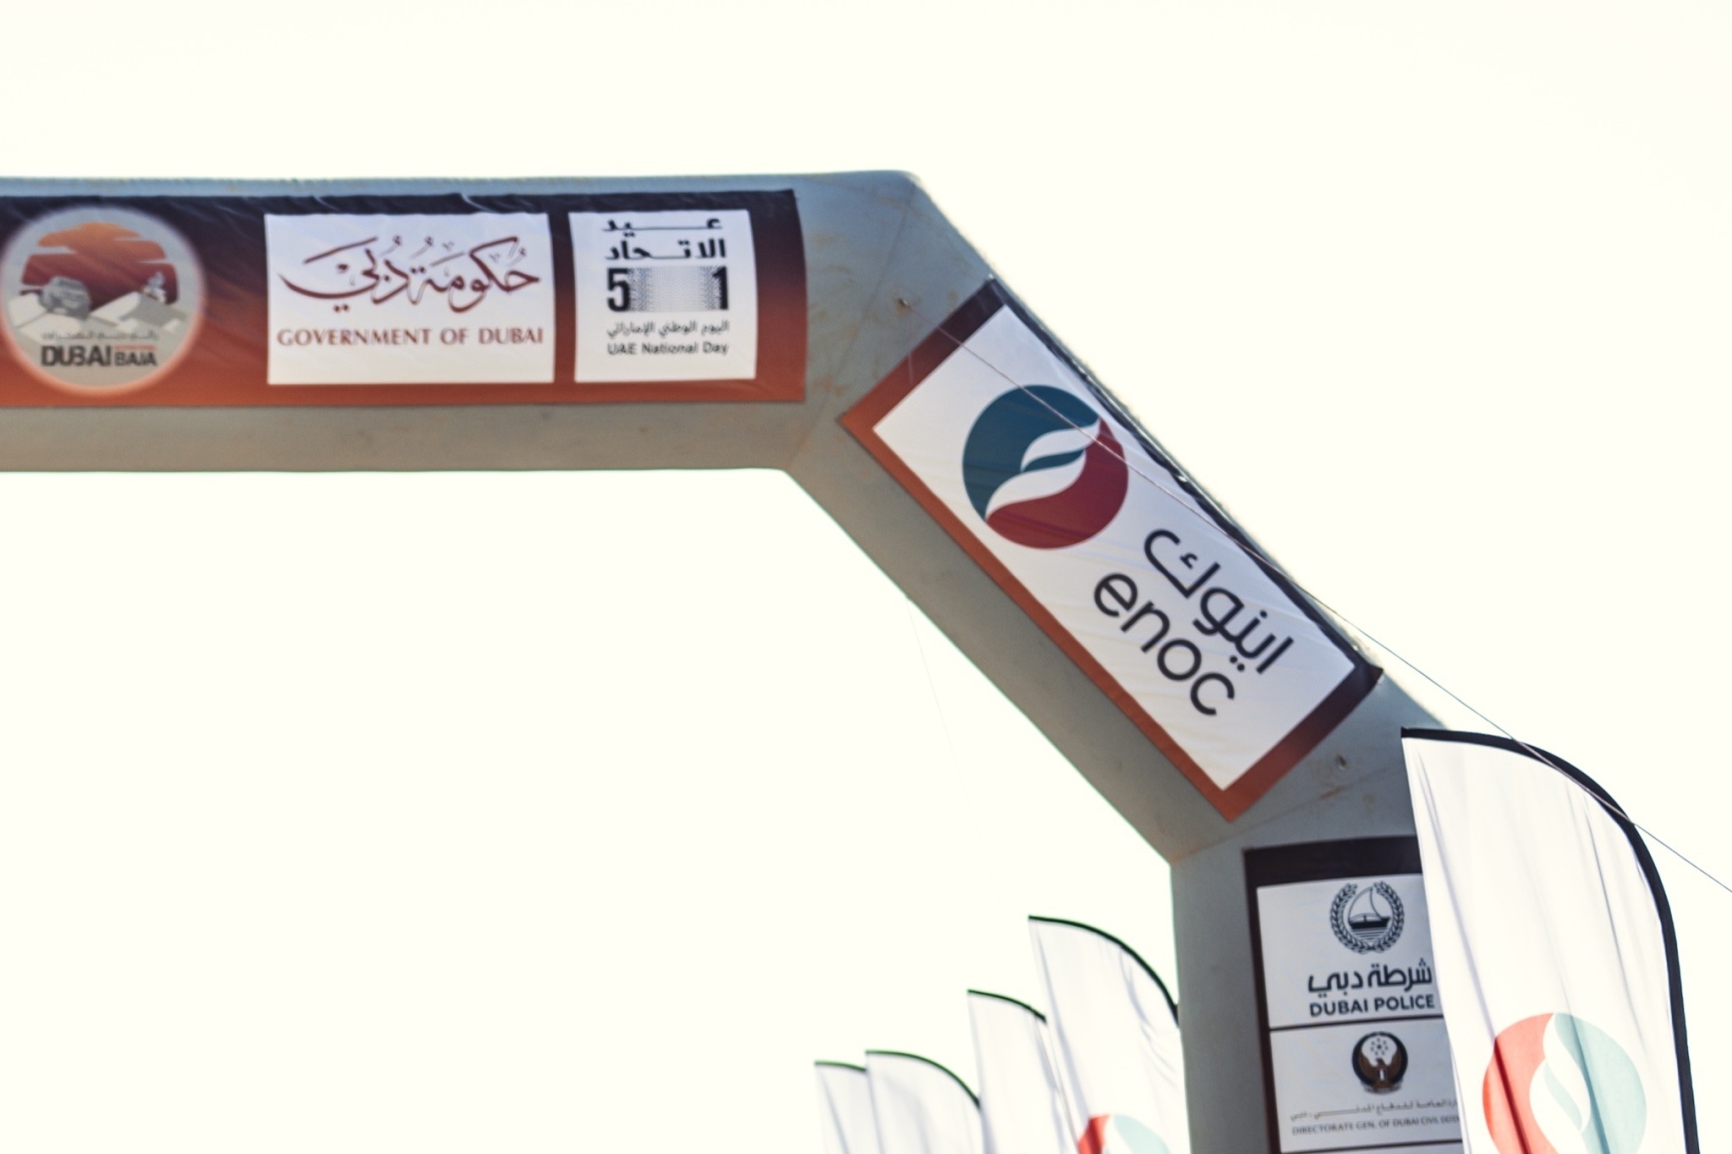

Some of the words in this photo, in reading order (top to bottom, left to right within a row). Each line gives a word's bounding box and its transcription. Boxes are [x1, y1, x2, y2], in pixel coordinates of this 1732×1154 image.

[277, 328, 431, 346] GOVERNMENT
[440, 328, 469, 345] OF
[478, 328, 544, 345] DUBAI
[607, 343, 636, 355] UAE
[642, 341, 698, 355] National
[703, 341, 728, 356] Day
[41, 345, 111, 367] DUBAI
[114, 351, 158, 367] BAJA
[1093, 572, 1235, 716] enoc
[1308, 969, 1364, 997] دبي
[1368, 958, 1433, 993] شرطة
[1310, 998, 1368, 1017] DUBAI
[1375, 994, 1435, 1012] POLICE
